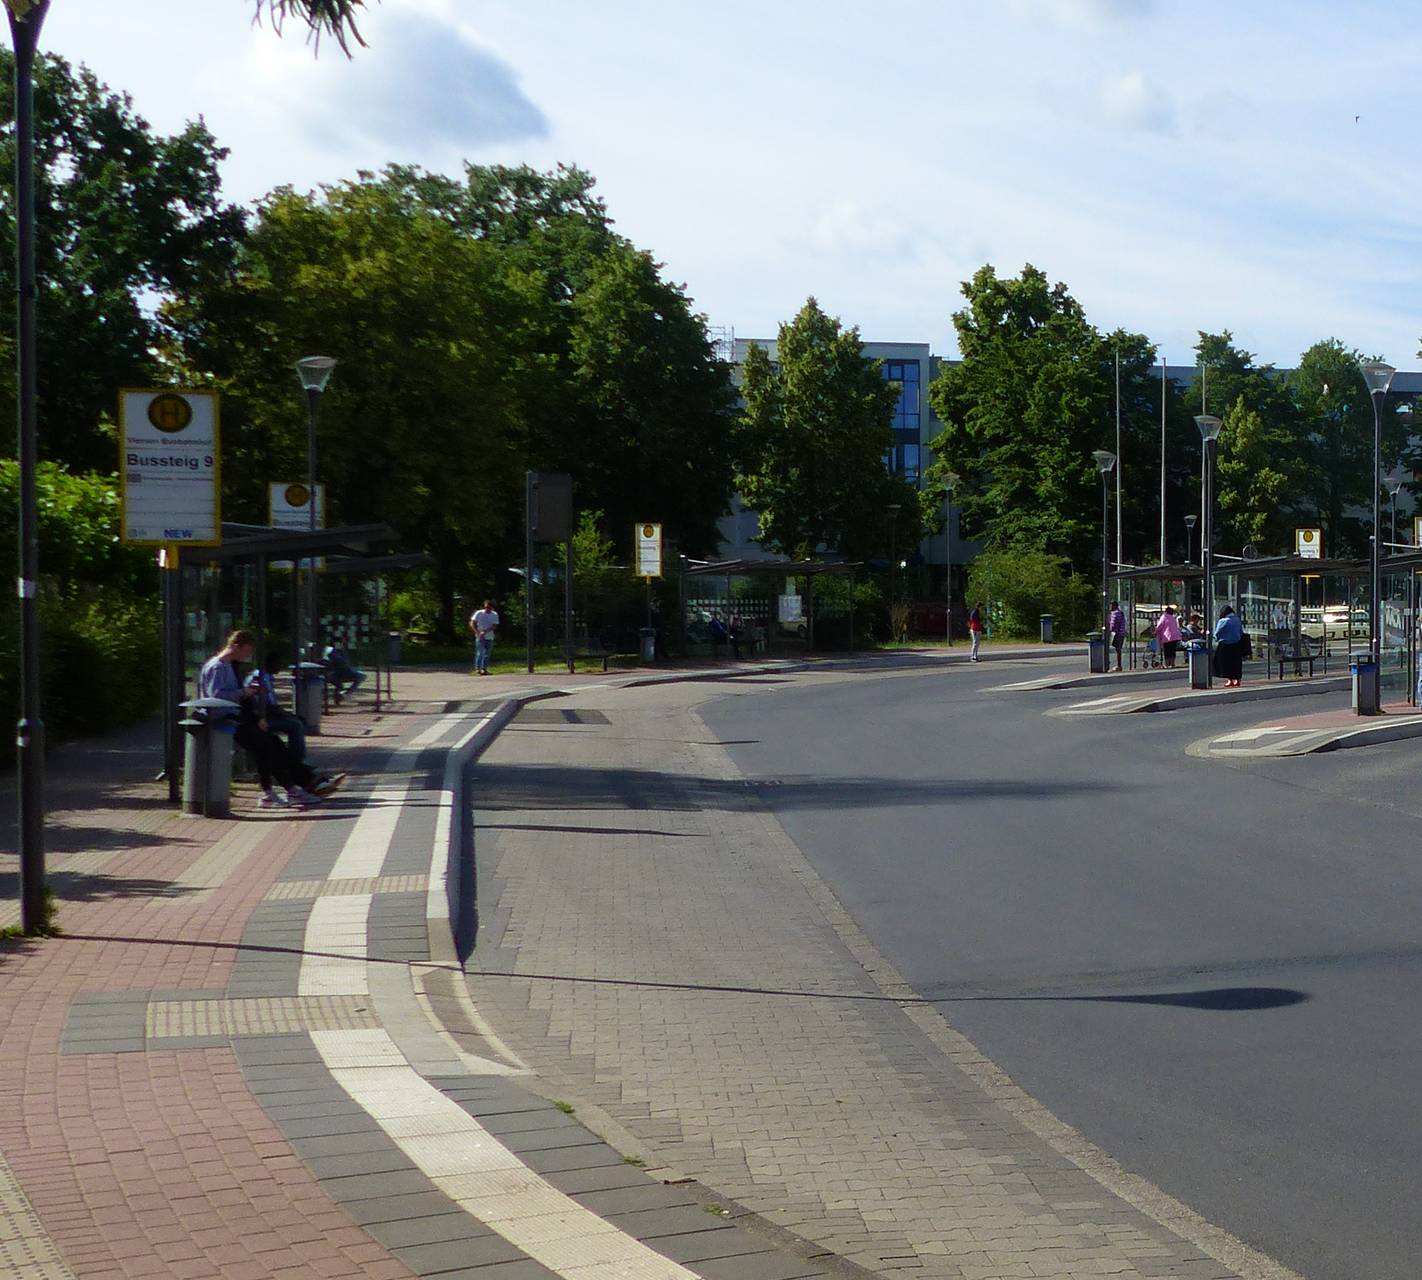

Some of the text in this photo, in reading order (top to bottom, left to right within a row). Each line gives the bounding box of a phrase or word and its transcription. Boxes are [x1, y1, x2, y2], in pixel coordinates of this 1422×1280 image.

[127, 453, 214, 470] Bussteig 9
[164, 528, 193, 539] NEW
